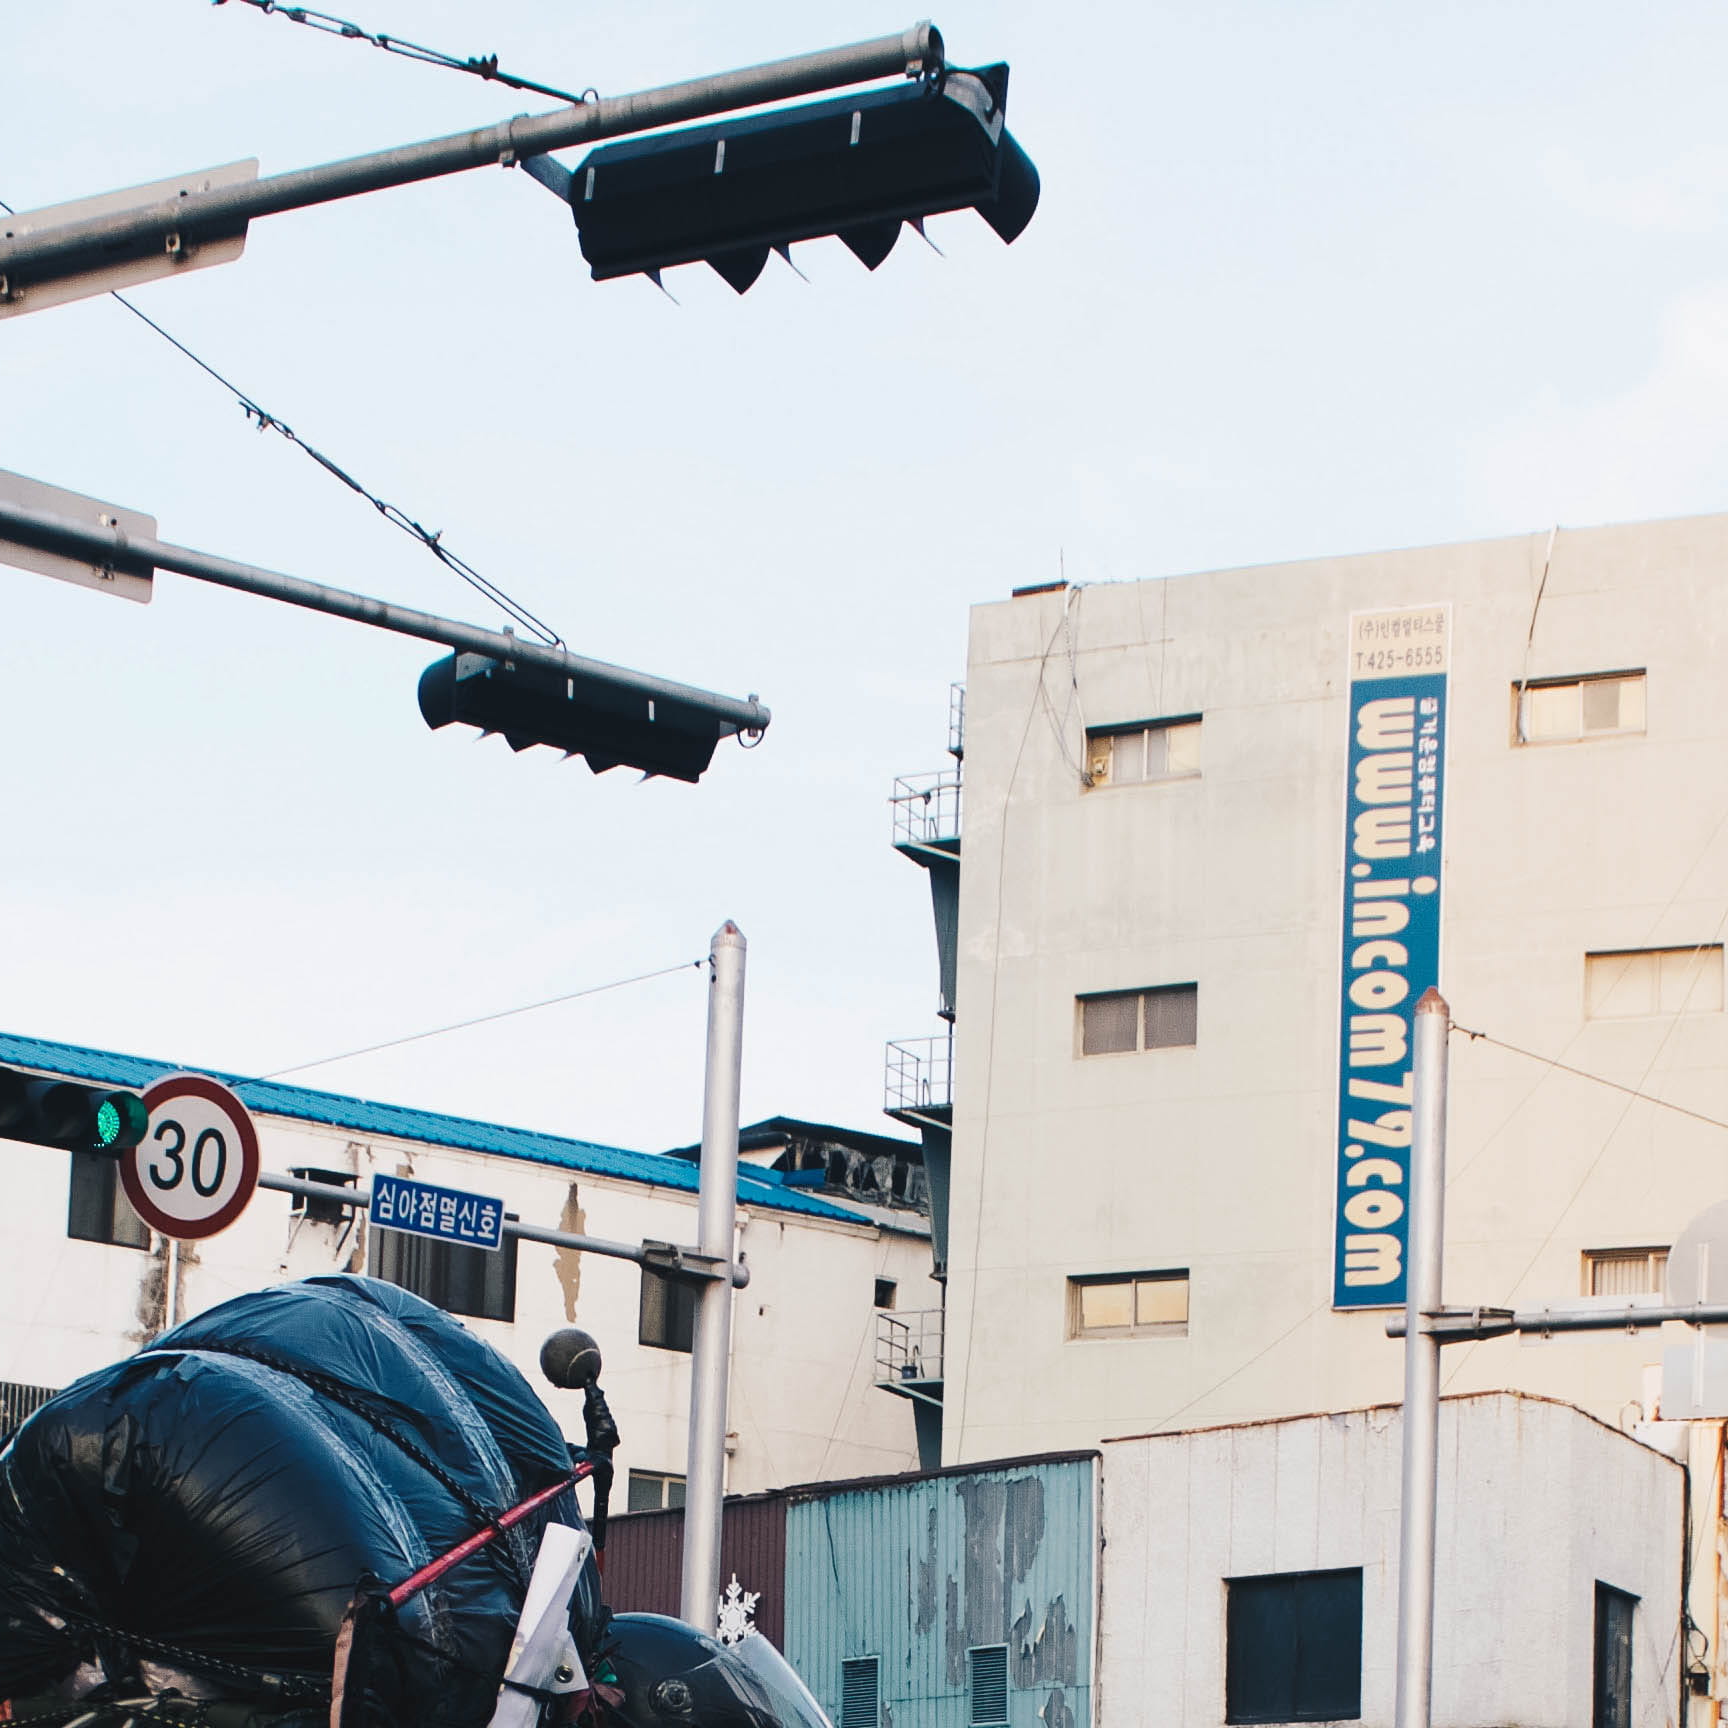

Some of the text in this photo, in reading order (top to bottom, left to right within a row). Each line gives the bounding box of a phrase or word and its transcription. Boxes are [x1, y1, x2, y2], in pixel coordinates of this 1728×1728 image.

[1343, 697, 1438, 1288] www.incom79.com
[148, 1119, 228, 1198] 30
[377, 1182, 497, 1241] 심야점멸신호
